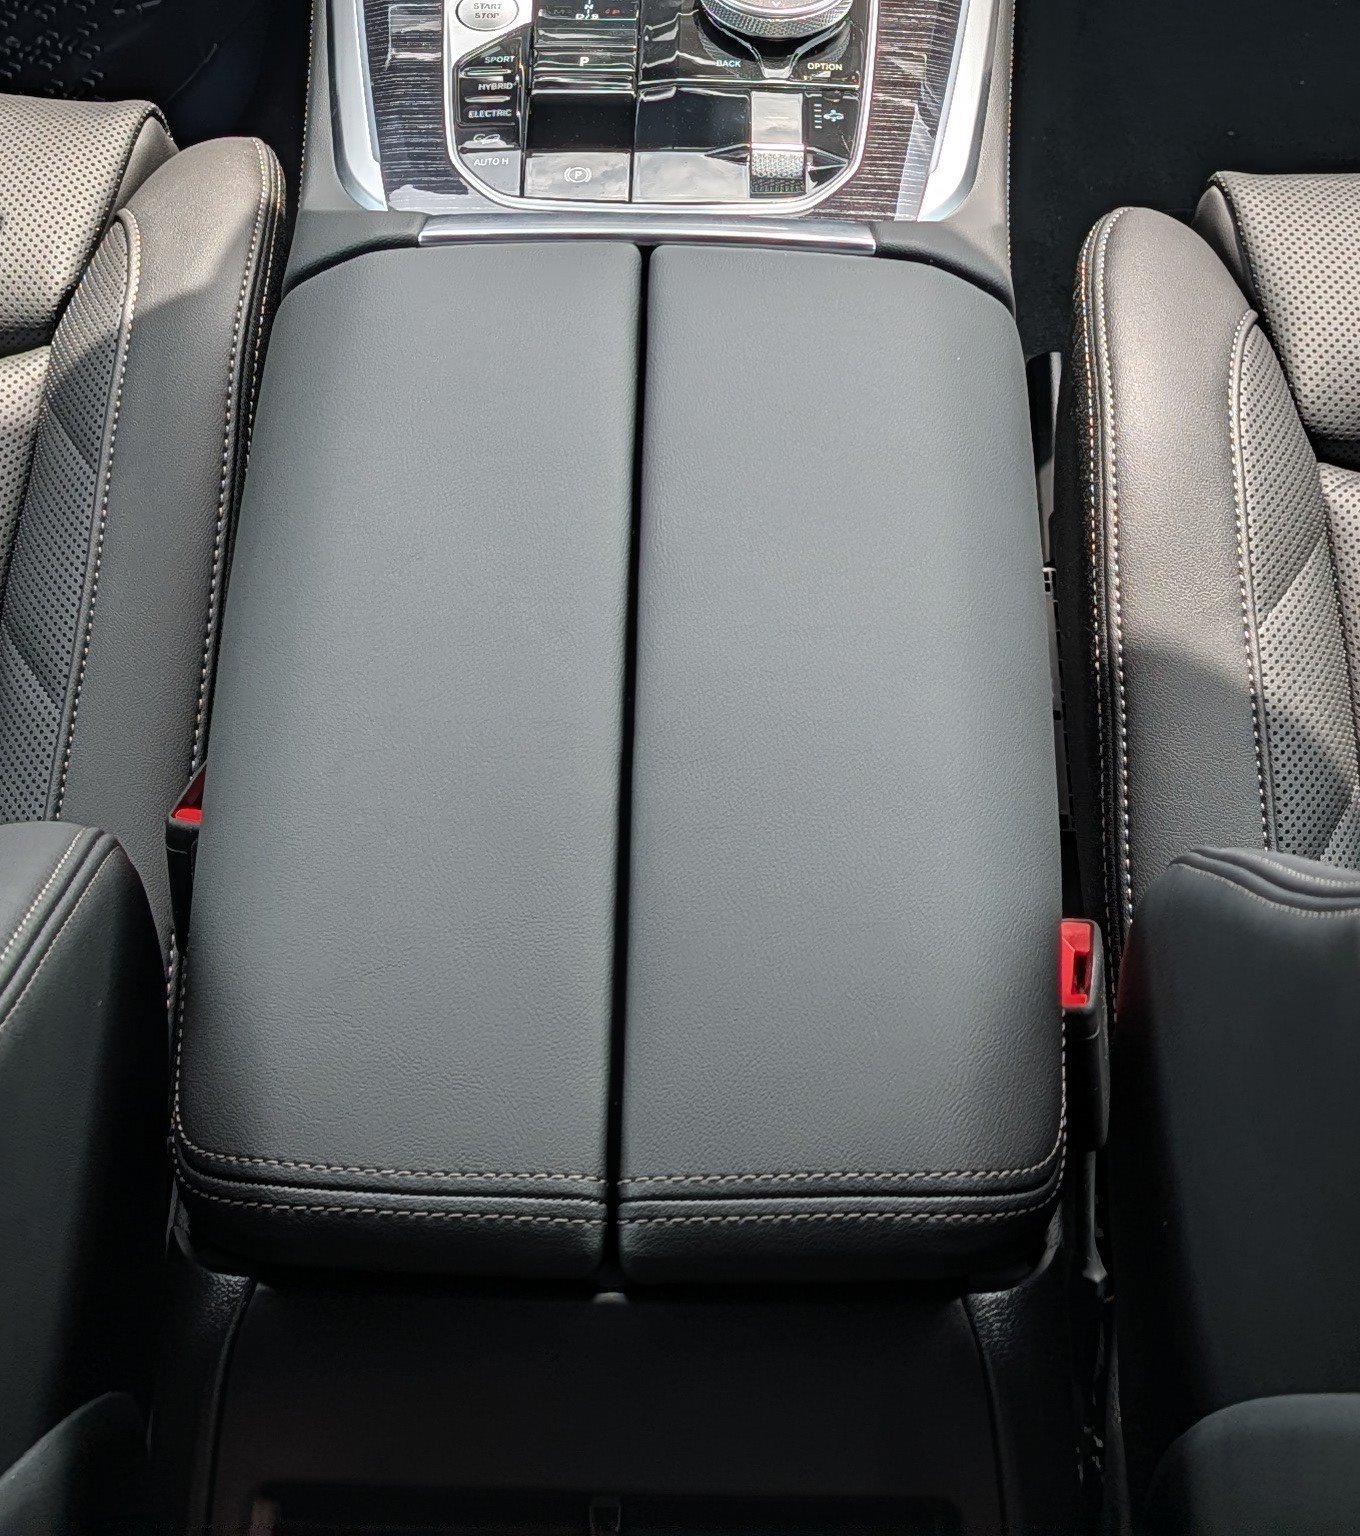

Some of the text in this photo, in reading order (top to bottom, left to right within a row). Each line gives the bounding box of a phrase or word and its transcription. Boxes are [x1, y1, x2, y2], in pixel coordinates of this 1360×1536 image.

[473, 2, 502, 10] START
[474, 12, 500, 20] STOP
[484, 55, 516, 64] SPORT
[579, 56, 590, 67] P
[716, 59, 742, 68] BACK
[807, 62, 843, 71] OPTION
[478, 82, 513, 91] HYBRID
[468, 109, 513, 119] ELECTRIC
[473, 157, 509, 166] AUTO H
